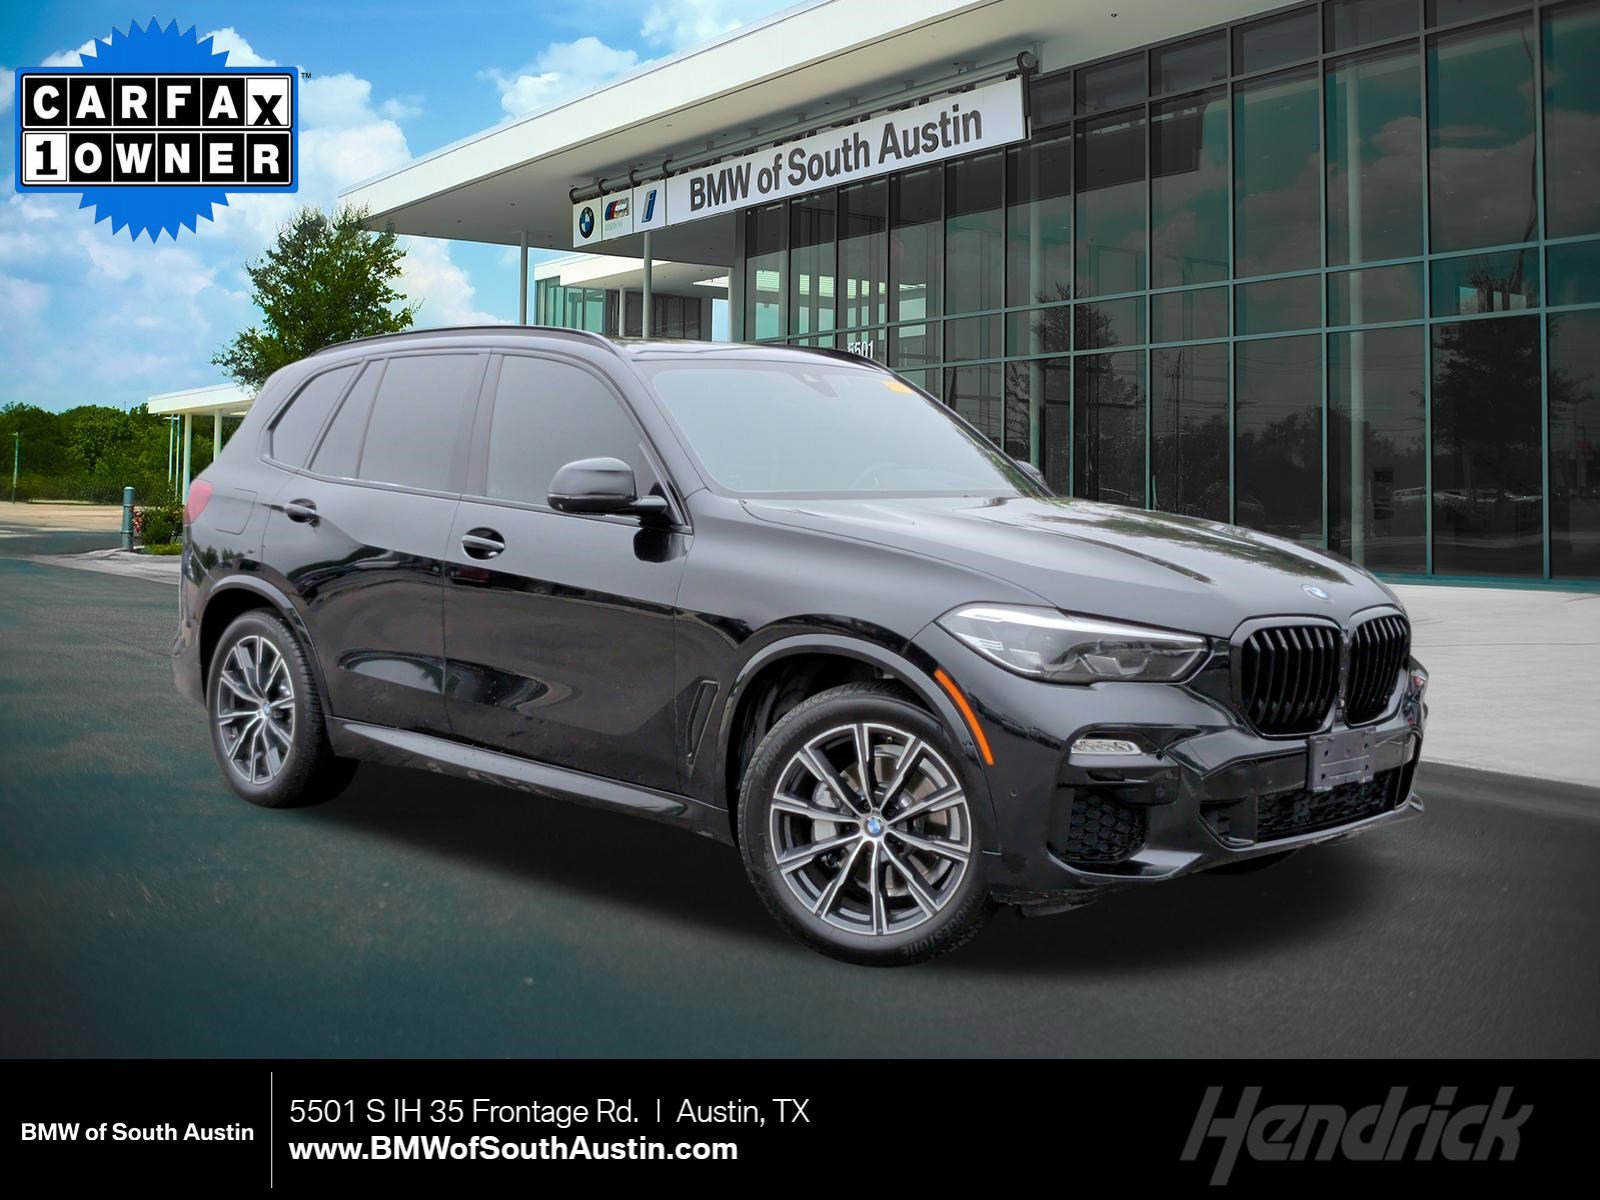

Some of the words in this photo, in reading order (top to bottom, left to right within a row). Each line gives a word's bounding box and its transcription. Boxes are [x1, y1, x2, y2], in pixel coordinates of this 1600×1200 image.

[690, 162, 751, 212] BMW
[757, 153, 783, 194] of
[787, 131, 870, 186] South
[878, 103, 983, 164] Austin
